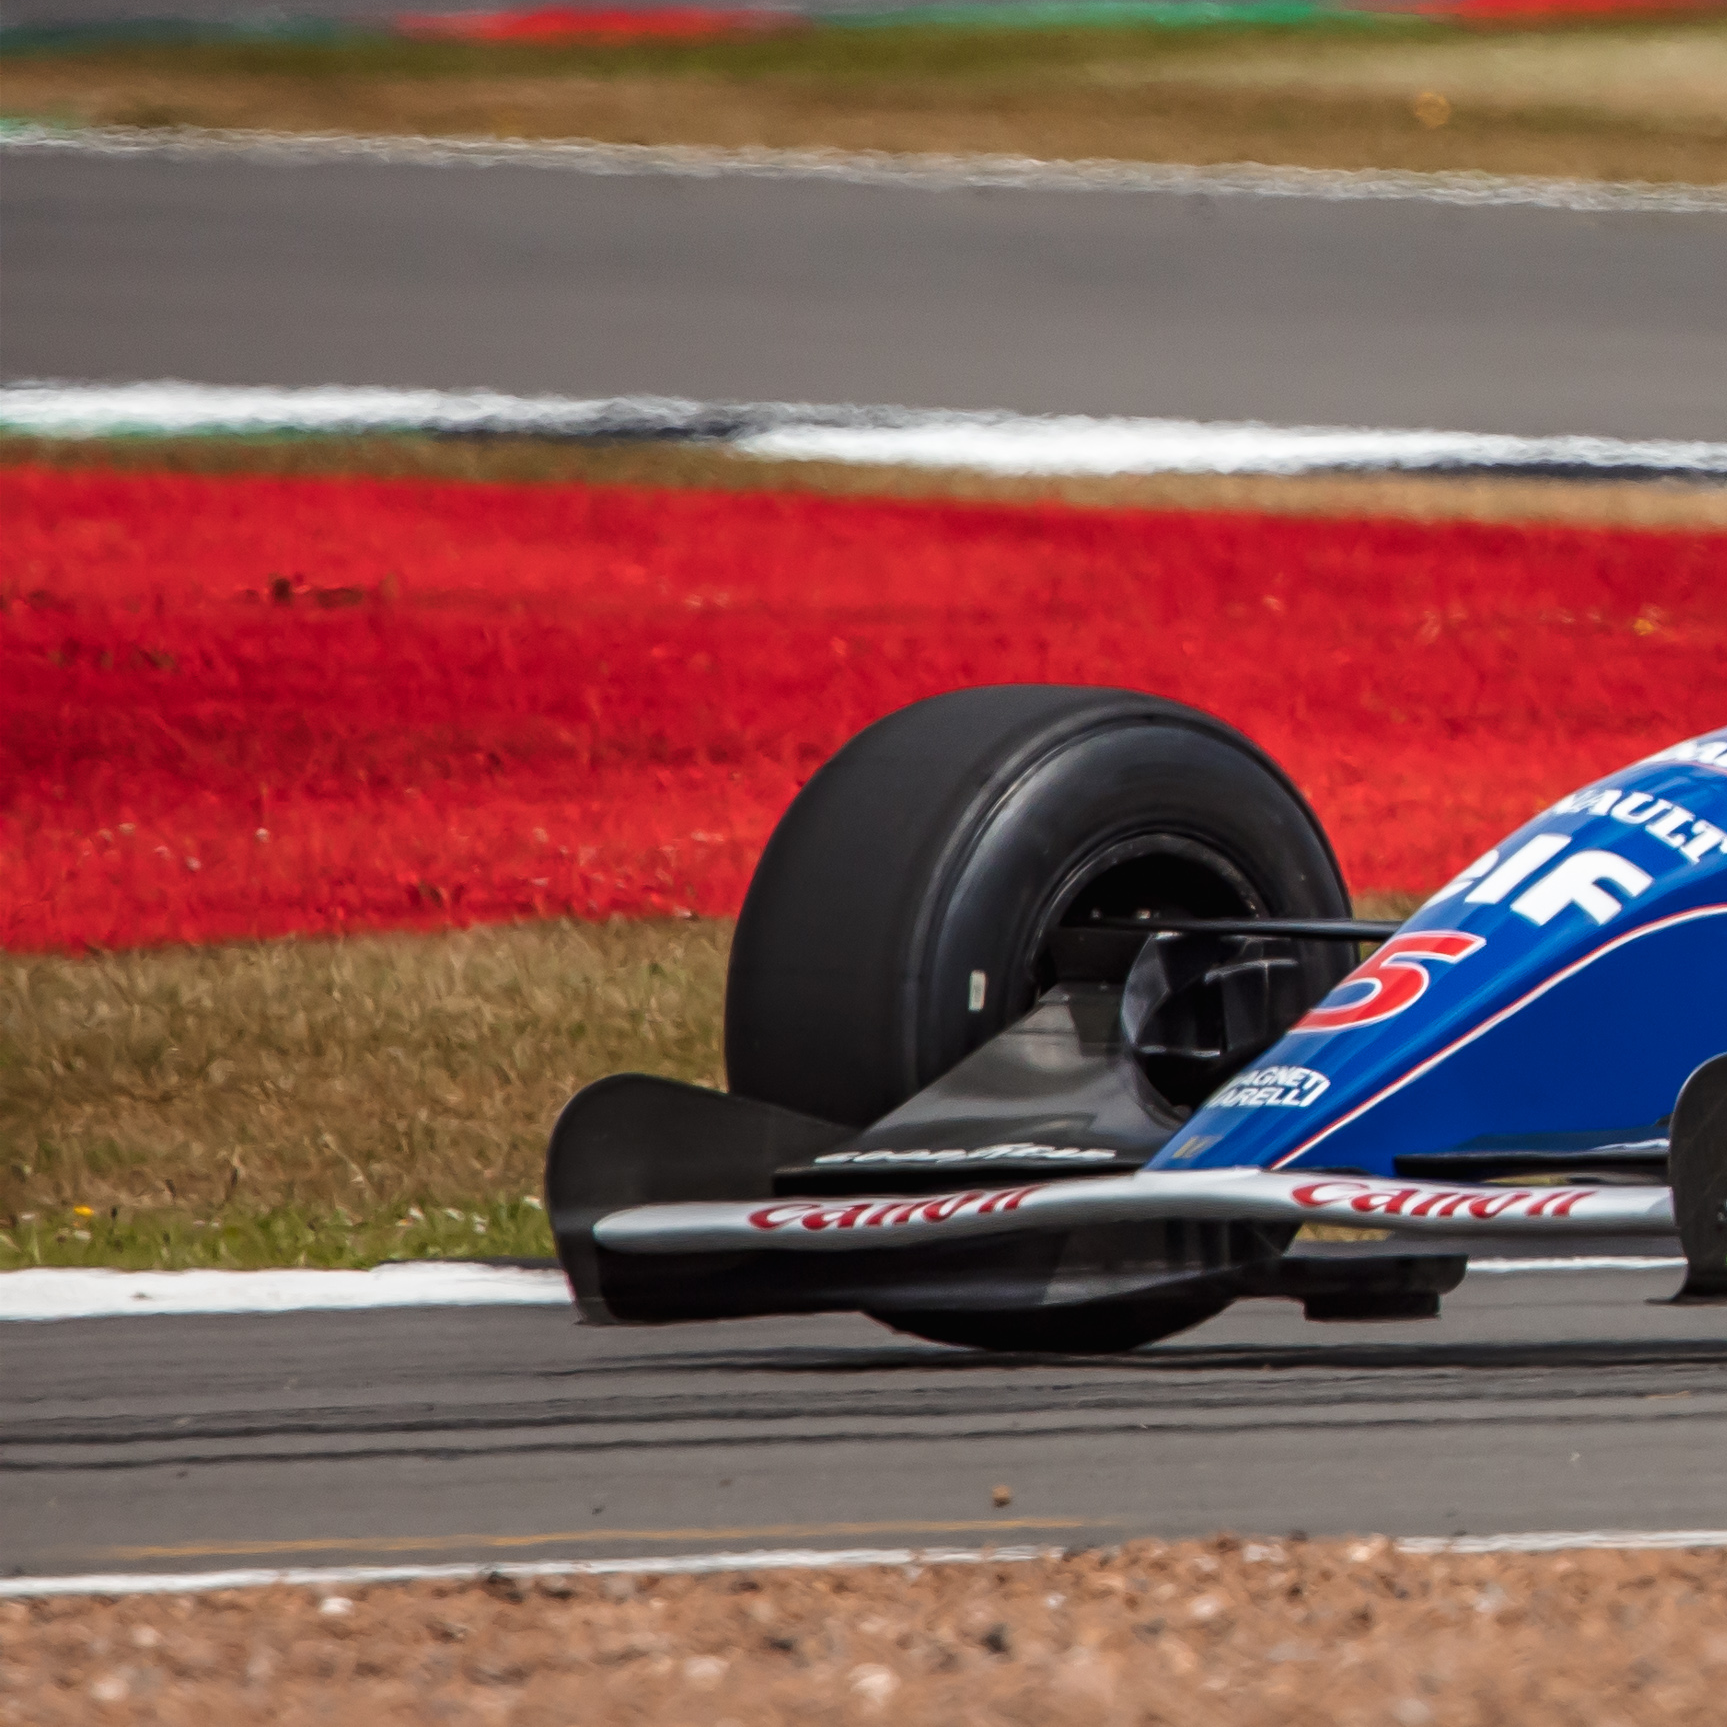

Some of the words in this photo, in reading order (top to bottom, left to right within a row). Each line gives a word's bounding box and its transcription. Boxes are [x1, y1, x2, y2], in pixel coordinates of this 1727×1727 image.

[1286, 929, 1487, 1034] 5
[748, 1184, 1049, 1231] Canon
[1290, 1181, 1599, 1220] Canon
